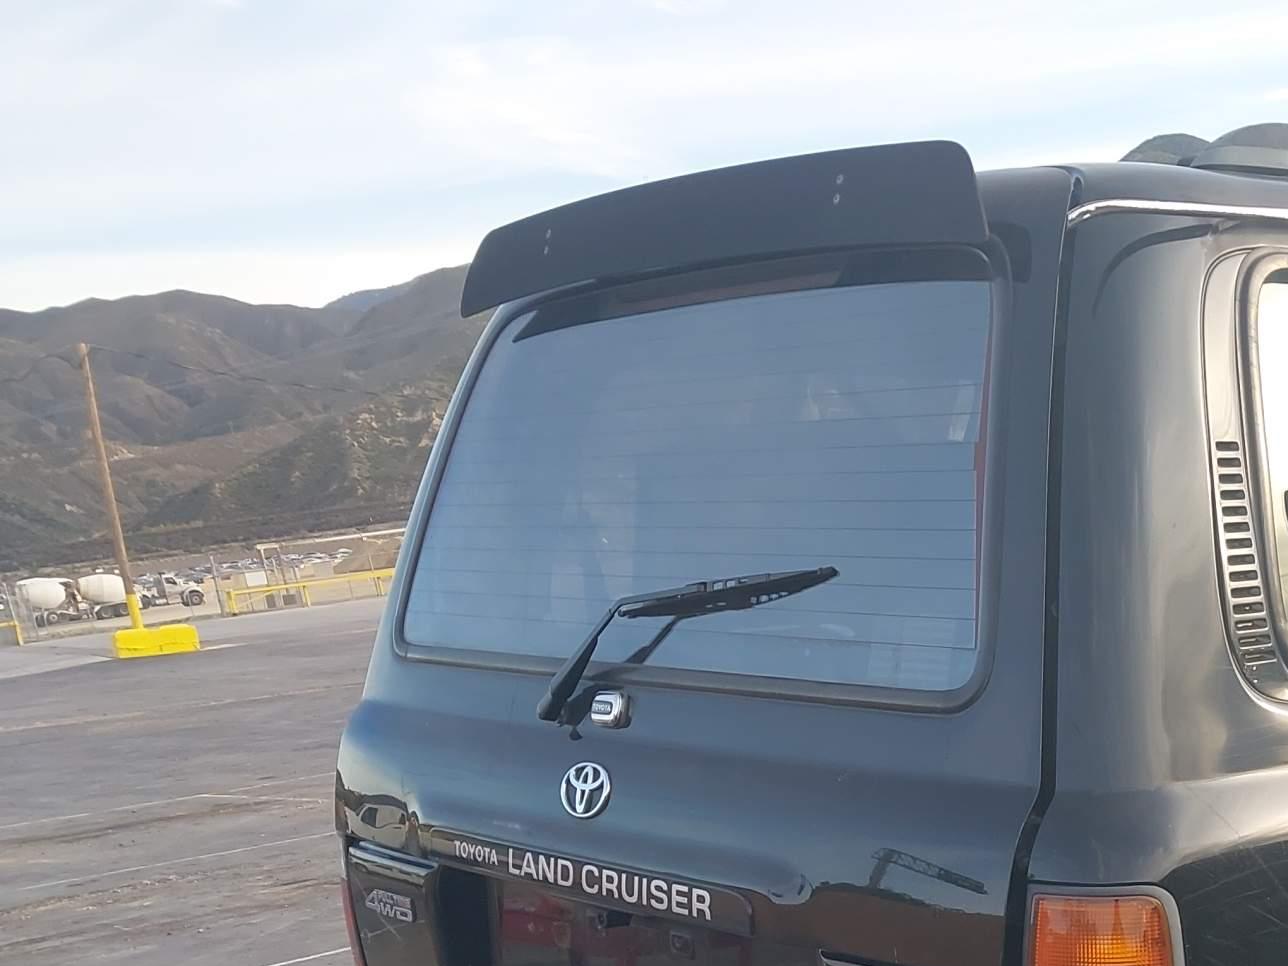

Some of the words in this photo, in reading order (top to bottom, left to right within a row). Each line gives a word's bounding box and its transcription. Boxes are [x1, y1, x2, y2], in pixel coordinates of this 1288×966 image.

[365, 889, 413, 922] 4WD
[453, 840, 499, 866] TOYOTA
[508, 848, 574, 887] LAND
[581, 865, 712, 921] CRUISER
